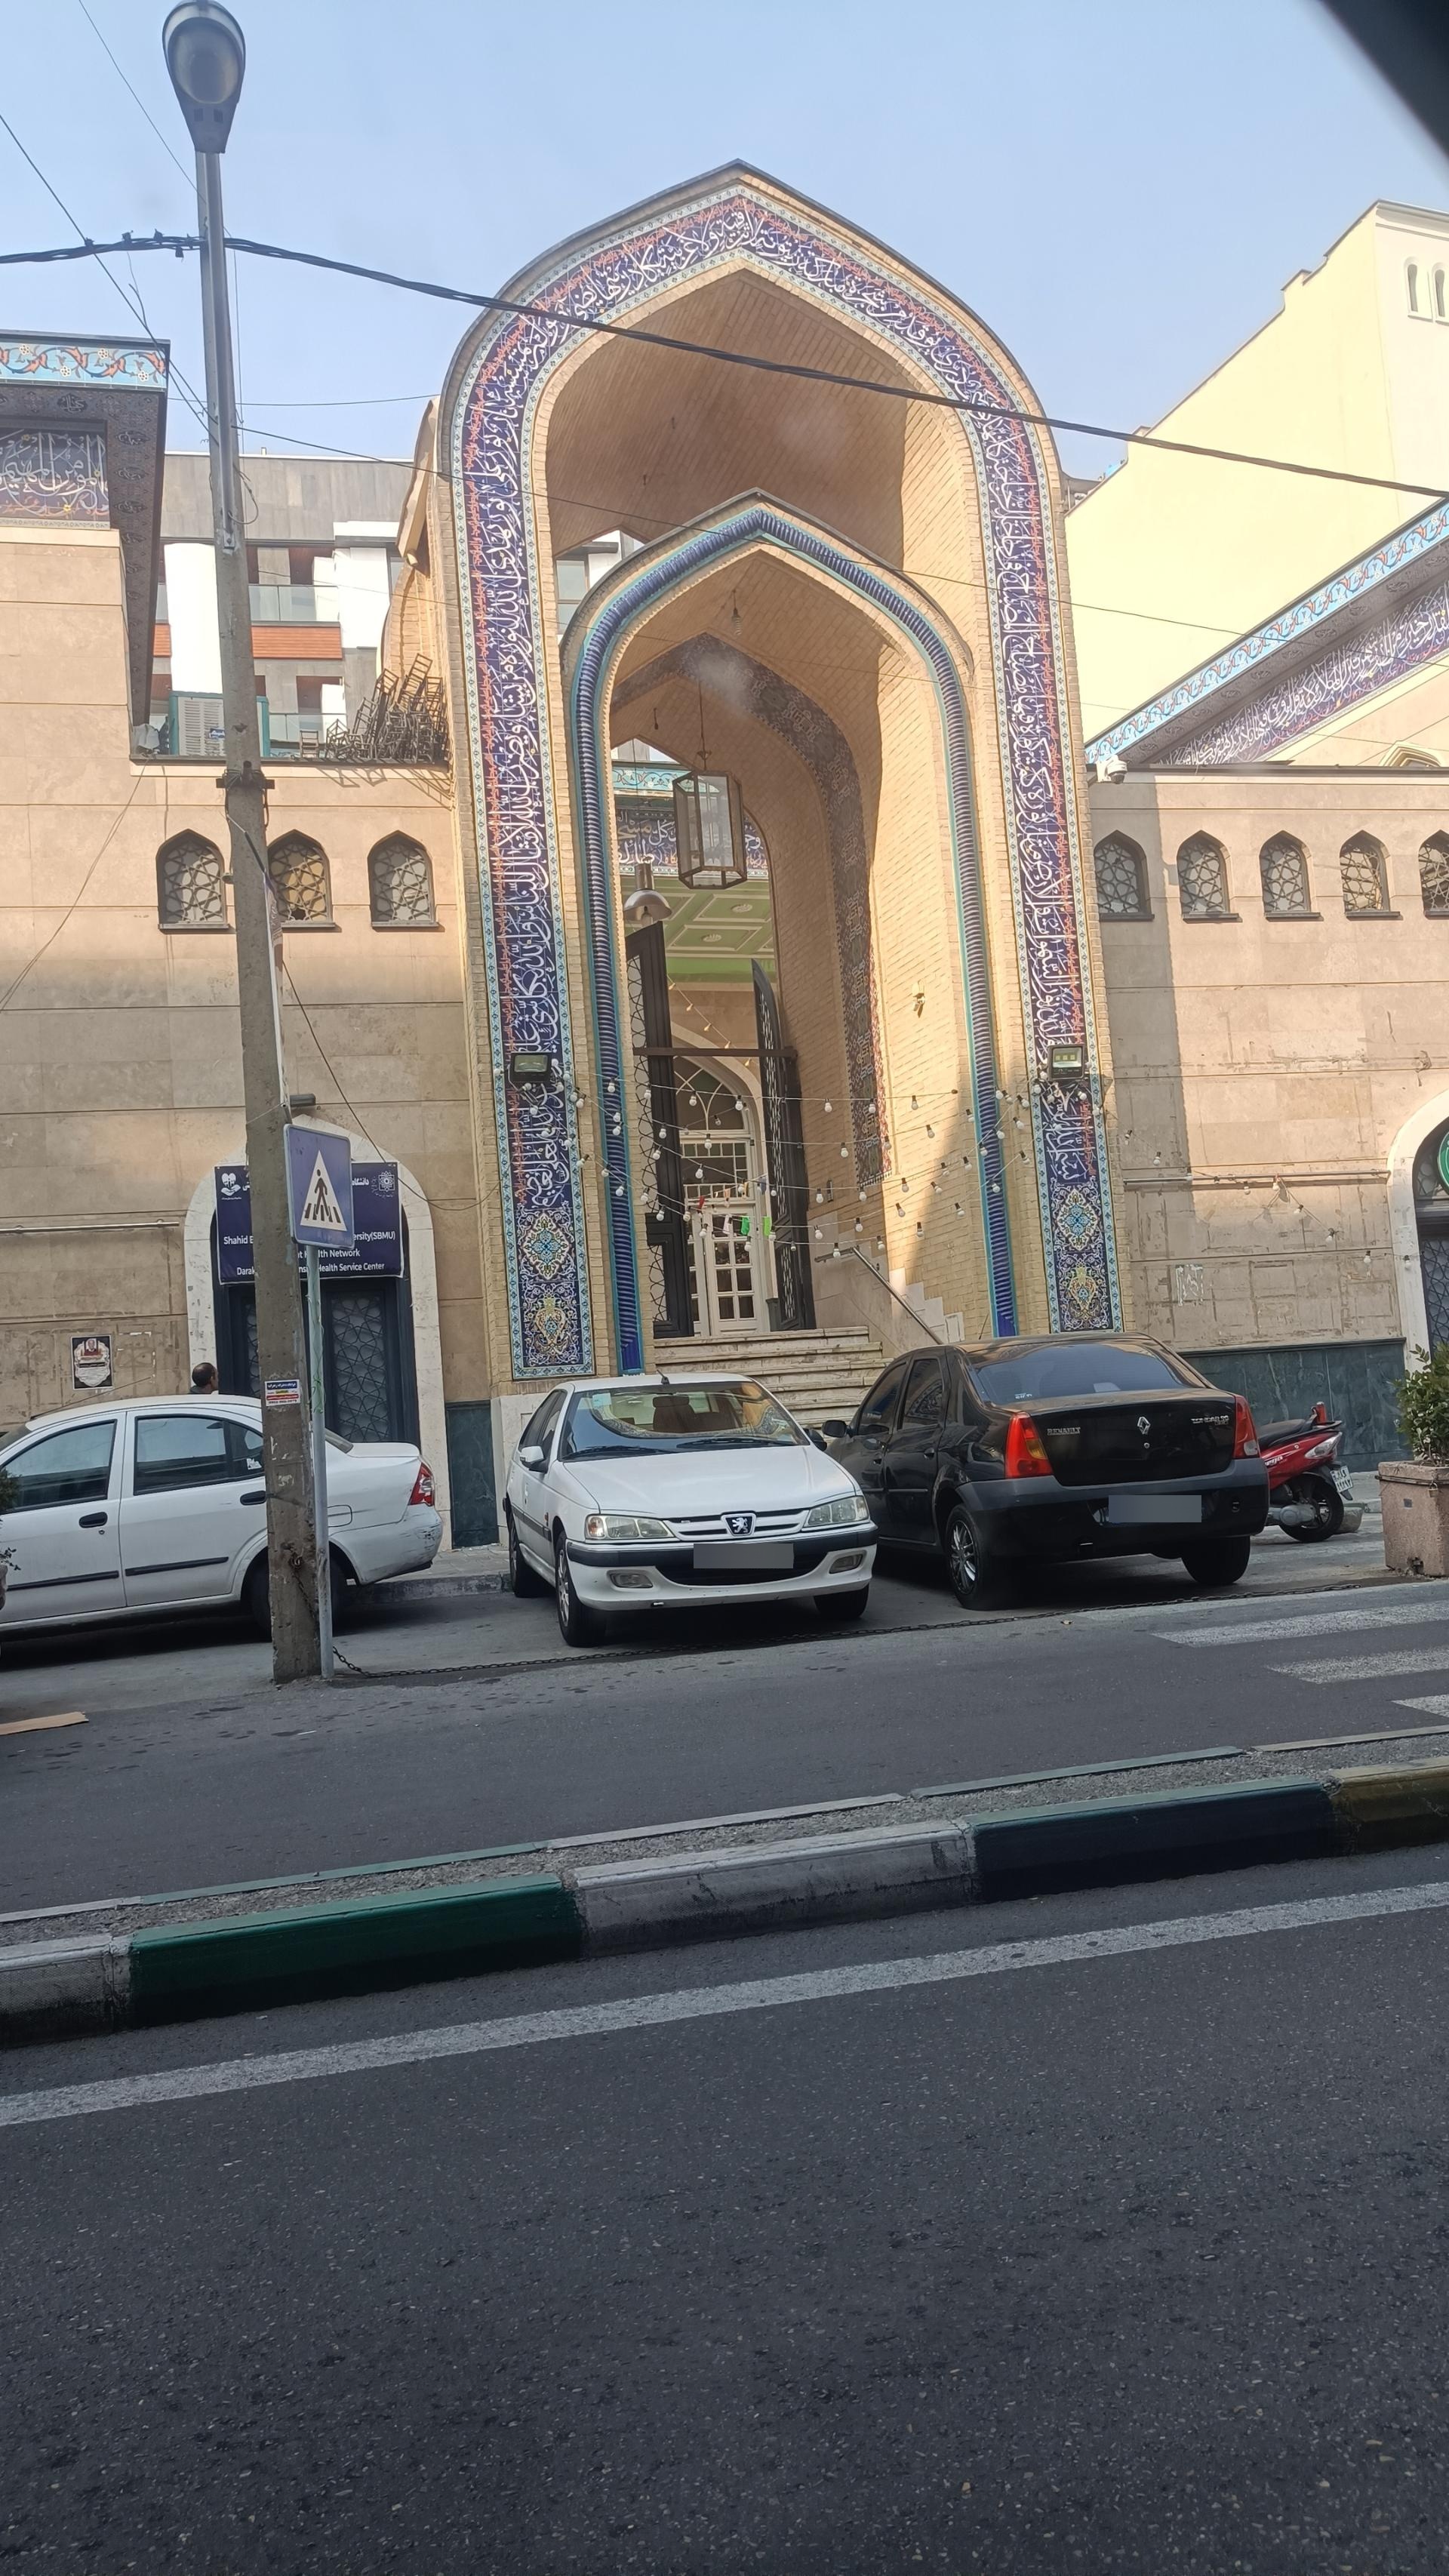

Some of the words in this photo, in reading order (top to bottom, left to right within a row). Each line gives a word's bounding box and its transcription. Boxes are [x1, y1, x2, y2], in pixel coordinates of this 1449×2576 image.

[223, 1236, 248, 1245] Shahid
[353, 1230, 395, 1242] ersity(SBMU)
[304, 1249, 328, 1258] Hlth
[330, 1248, 360, 1257] Network
[236, 1266, 255, 1276] Darak
[339, 1262, 362, 1271] Service
